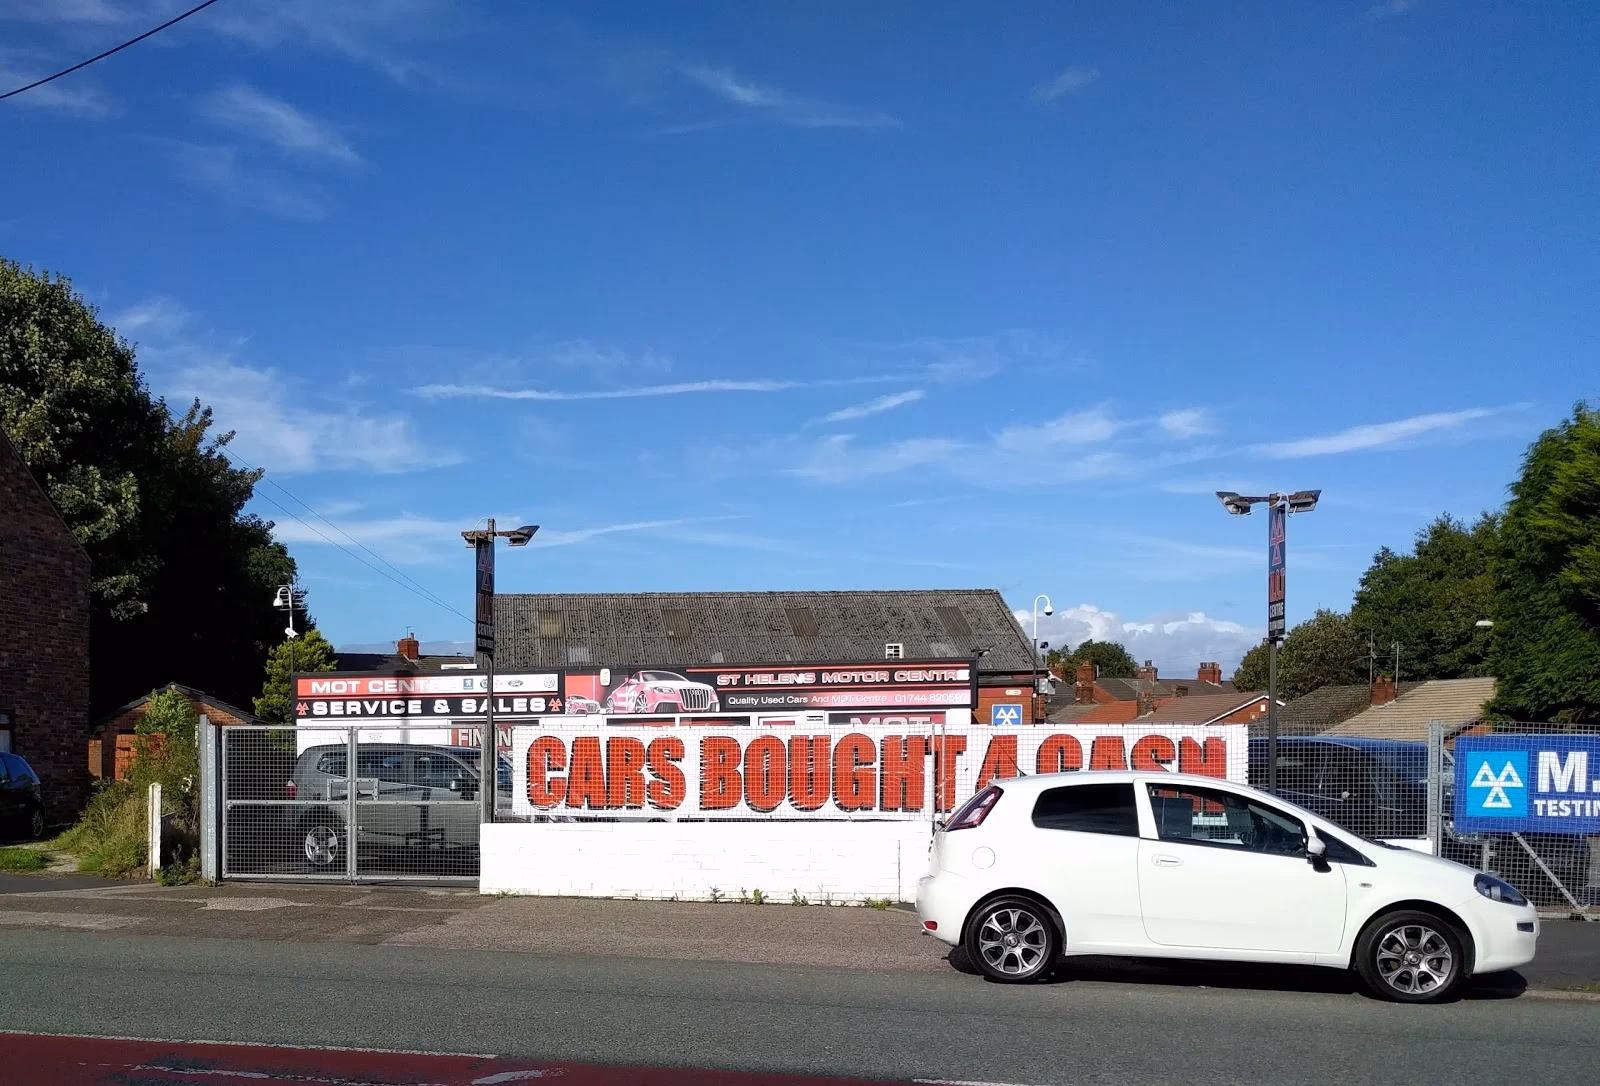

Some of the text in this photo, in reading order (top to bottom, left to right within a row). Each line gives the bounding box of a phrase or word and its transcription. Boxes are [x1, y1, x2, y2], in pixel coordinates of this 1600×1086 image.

[312, 678, 457, 694] MOT CENT
[717, 669, 970, 686] ST HELENS MOTOR CENTRE
[313, 697, 546, 716] SERVICE & SALES
[728, 695, 759, 705] Quality
[761, 695, 784, 704] Used
[786, 695, 808, 704] Cars
[811, 694, 829, 703] And
[832, 694, 855, 703] MOT
[857, 694, 888, 703] Centre
[895, 693, 927, 703] 01744
[527, 735, 686, 812] CARS
[699, 732, 967, 813] BOUGHT
